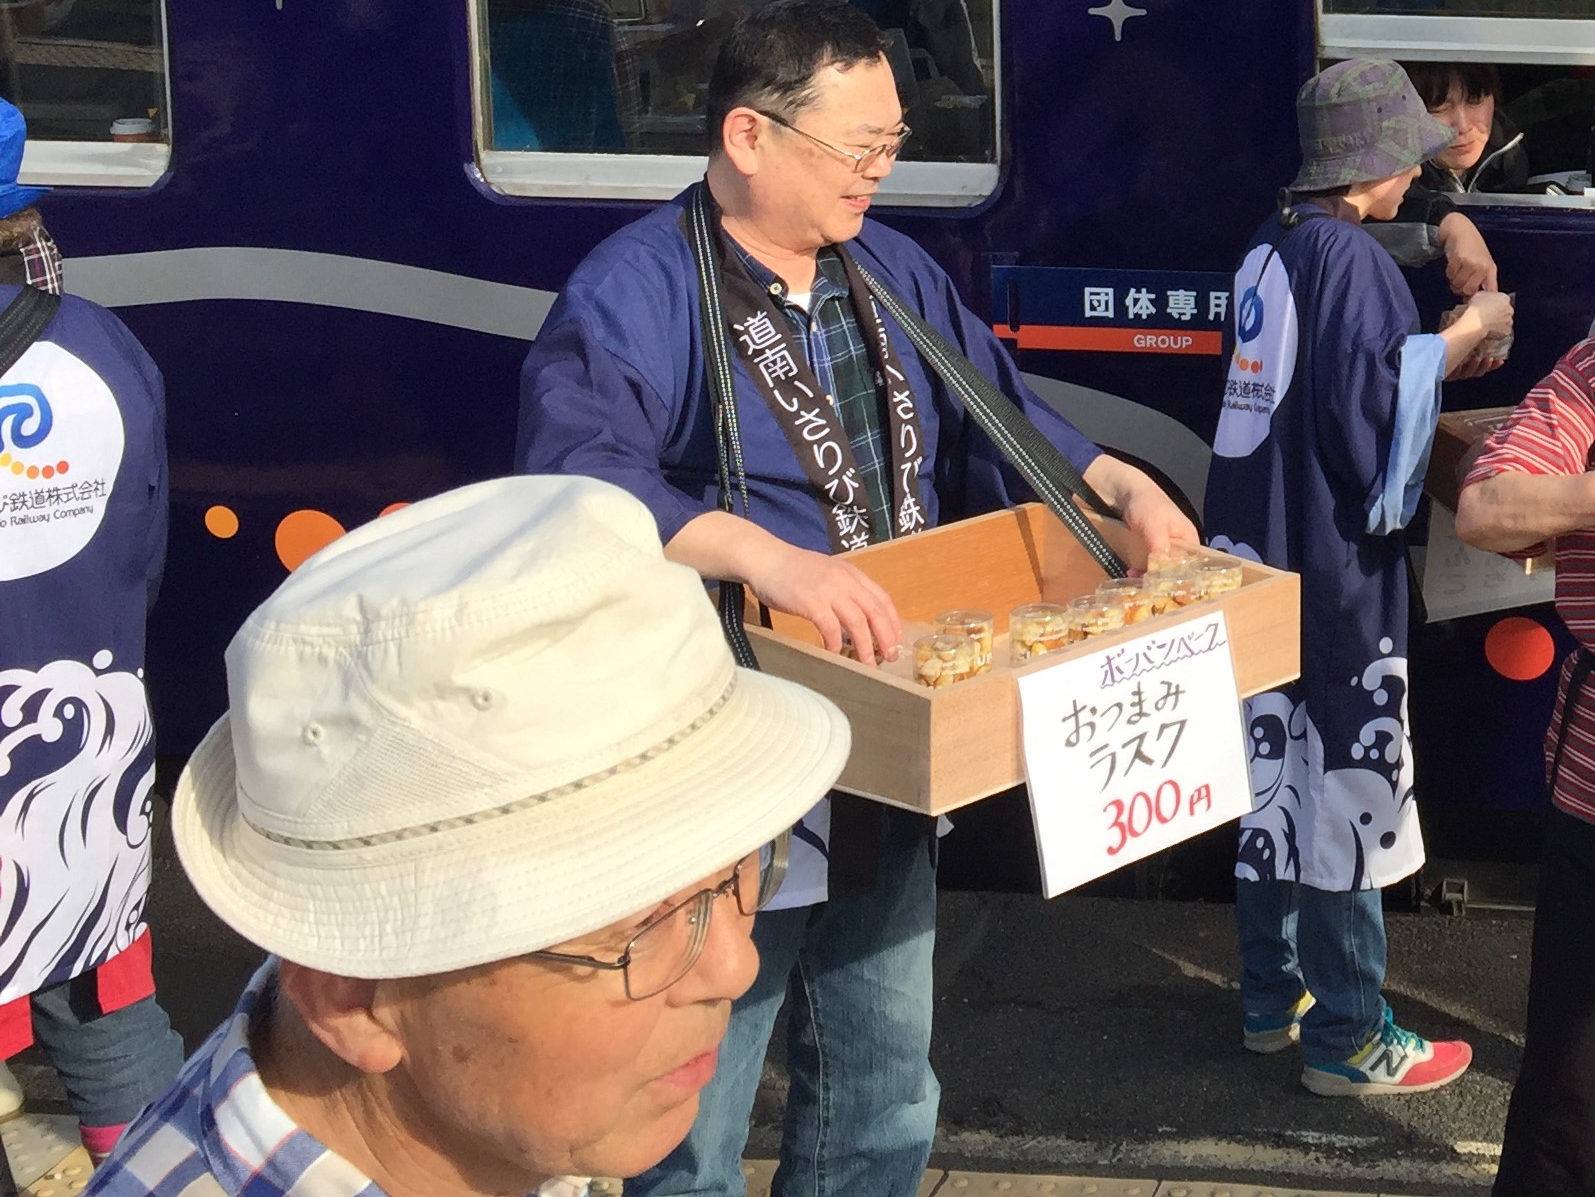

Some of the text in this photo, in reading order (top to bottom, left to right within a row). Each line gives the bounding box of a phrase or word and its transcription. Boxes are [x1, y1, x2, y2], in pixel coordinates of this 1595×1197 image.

[1084, 286, 1230, 322] 団体専用
[1133, 334, 1193, 349] GROUP
[10, 513, 50, 526] Railway
[53, 505, 94, 520] Company
[1061, 680, 1187, 748] おつまみ
[1088, 718, 1188, 794] ラスク
[1102, 779, 1212, 857] 300円
